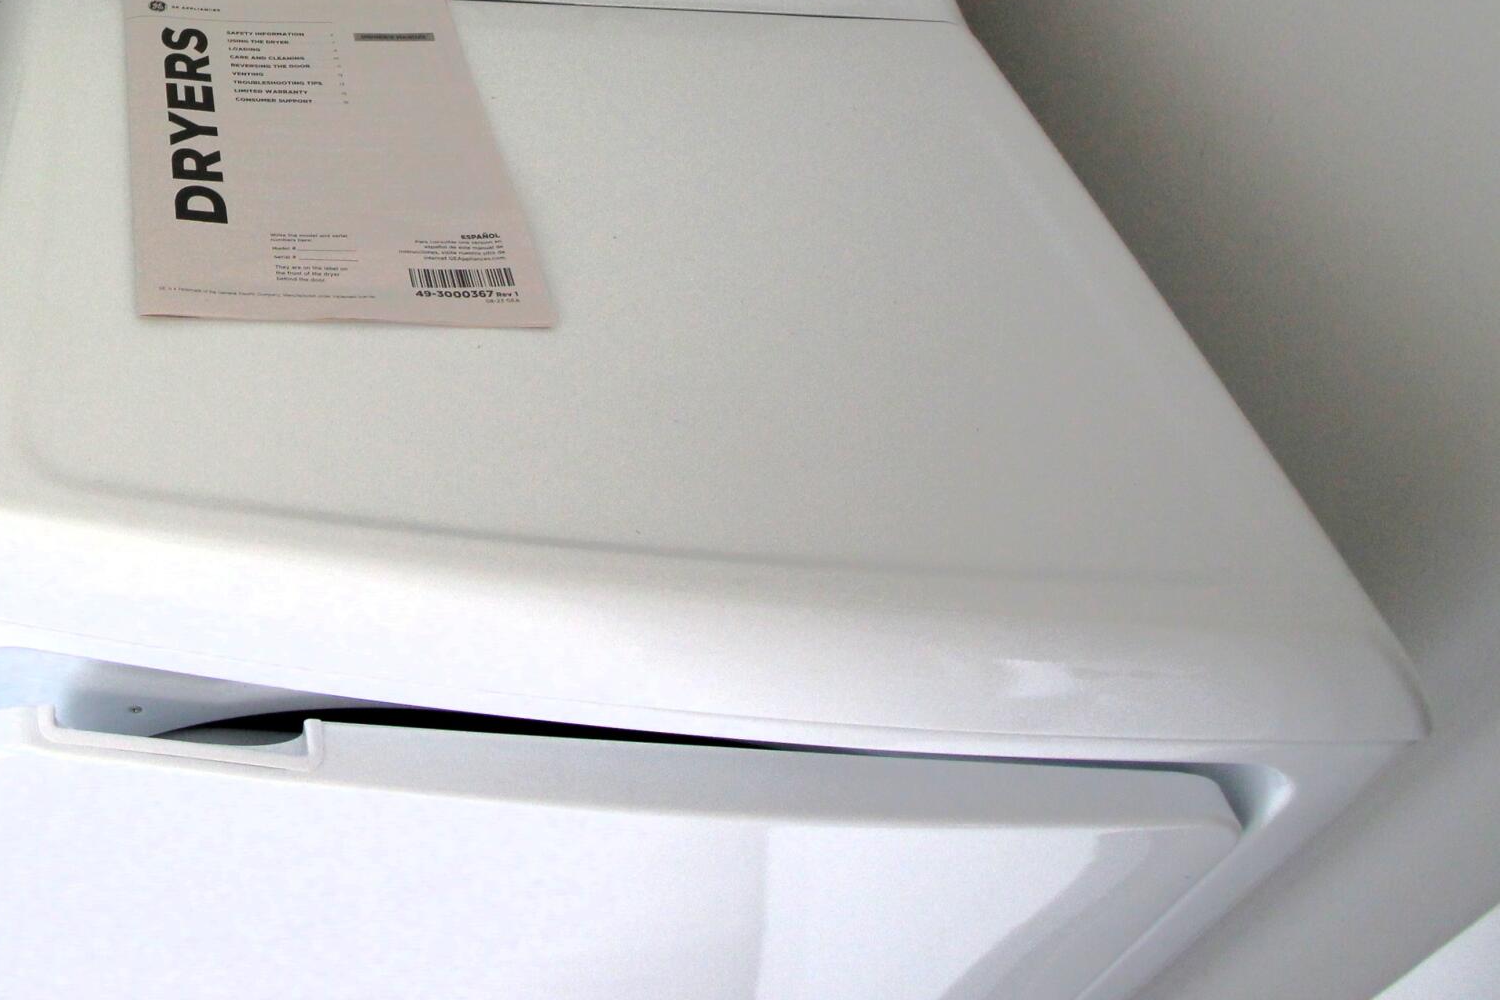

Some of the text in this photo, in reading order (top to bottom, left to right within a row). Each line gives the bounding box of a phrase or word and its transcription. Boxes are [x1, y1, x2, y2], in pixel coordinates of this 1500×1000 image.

[161, 27, 228, 224] DRYERS
[460, 231, 501, 240] ESPAÑOL
[415, 290, 494, 299] 49-3000367
